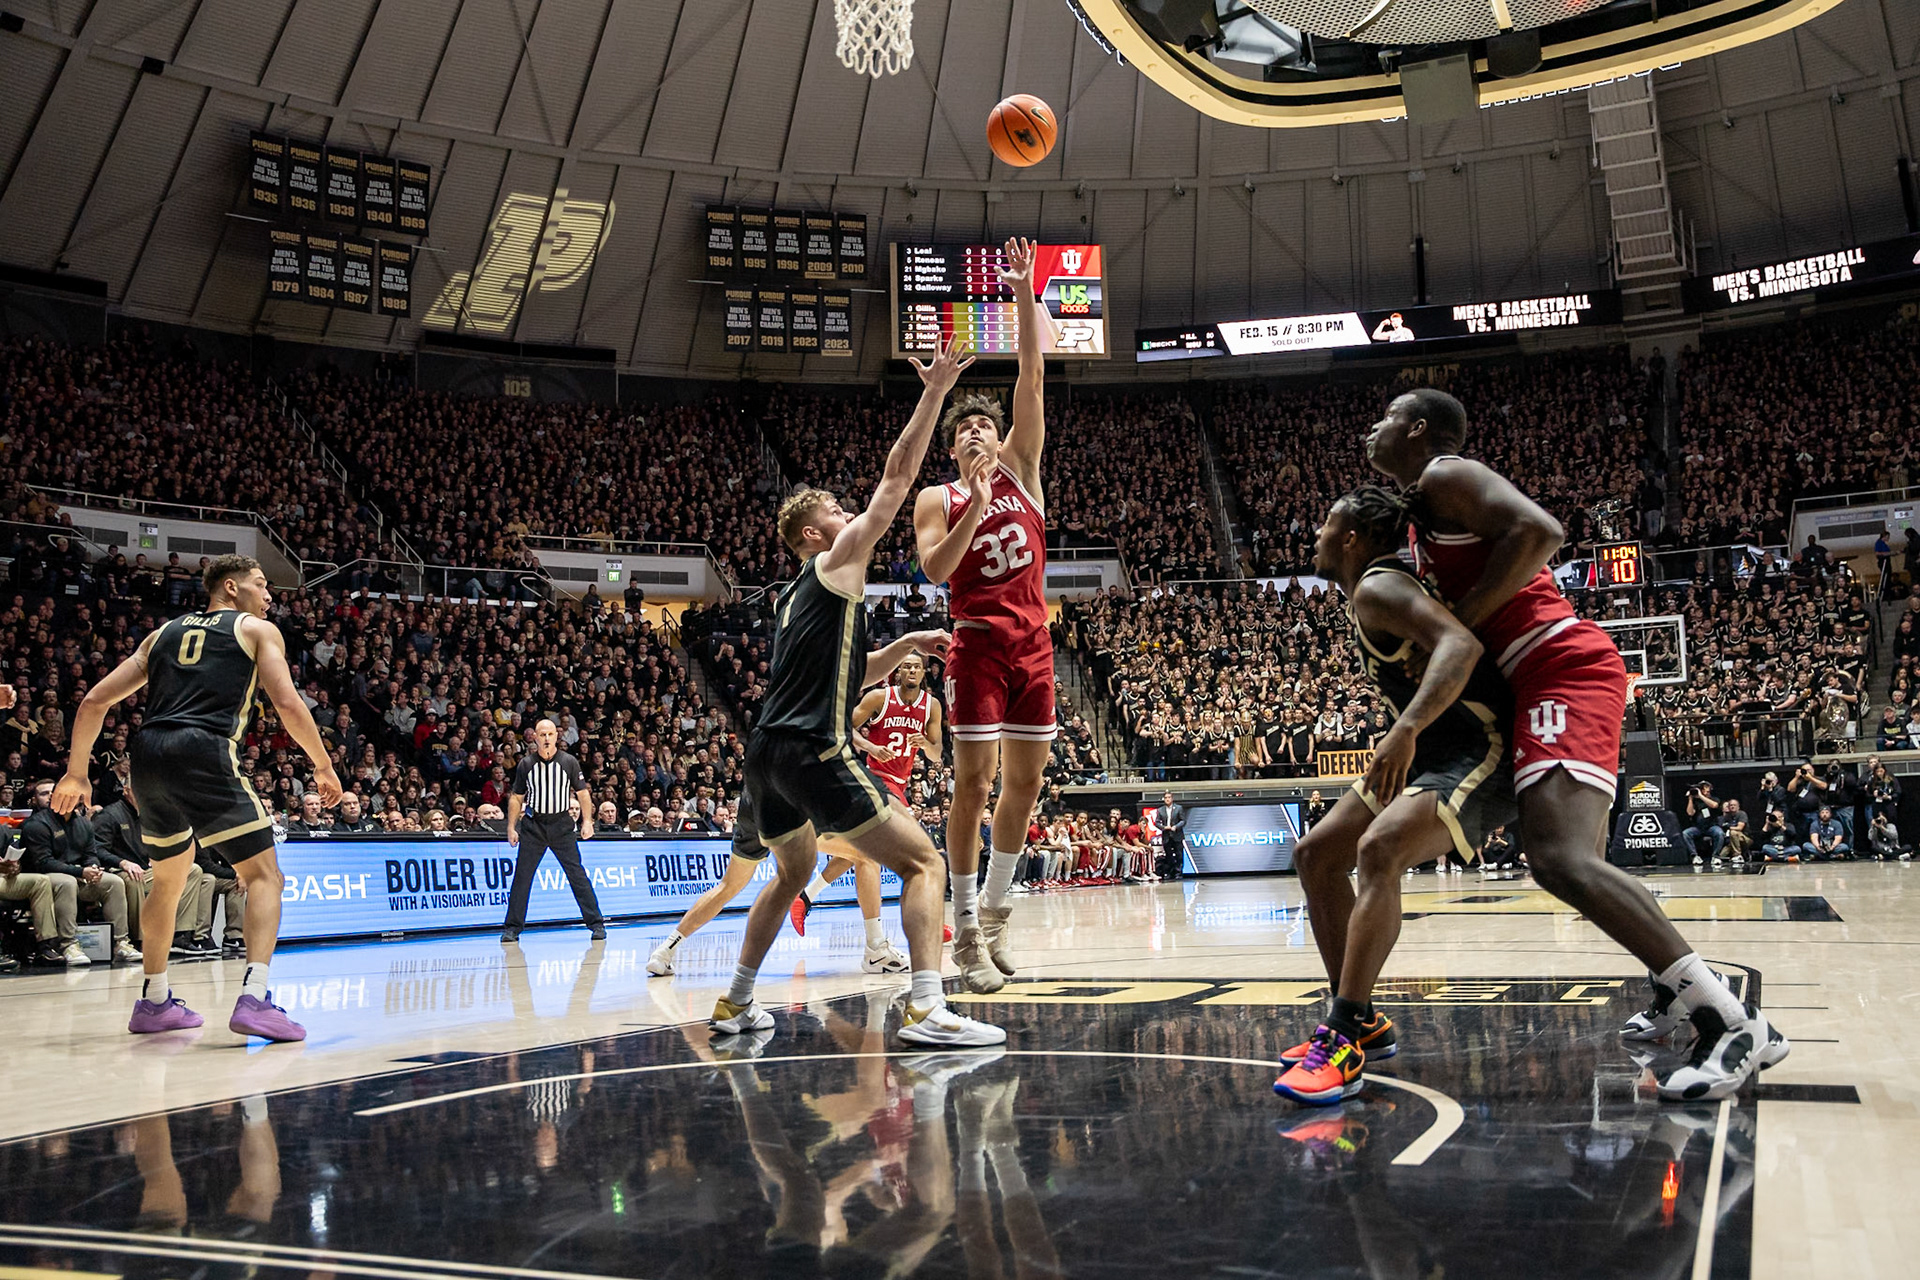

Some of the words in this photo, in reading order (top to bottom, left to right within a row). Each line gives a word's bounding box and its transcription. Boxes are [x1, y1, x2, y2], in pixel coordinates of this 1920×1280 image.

[253, 139, 282, 153] PURDUE
[291, 147, 320, 161] PURDUE
[257, 158, 277, 169] MEN'S
[328, 154, 357, 168] PURDUE
[254, 165, 265, 174] BIG
[267, 168, 279, 177] TEN
[294, 166, 315, 176] MEN'S
[365, 162, 393, 174] PURDUE
[253, 173, 280, 186] CHAMPS
[291, 173, 303, 182] BIG
[304, 175, 317, 185] TEN
[332, 173, 353, 183] MEN'S
[400, 168, 428, 181] PURDUE
[290, 180, 318, 192] CHAMPS
[330, 181, 341, 189] BIG
[343, 183, 355, 191] TEN
[254, 189, 278, 203] 1935
[328, 187, 356, 198] CHAMPS
[291, 195, 316, 211] 1936
[330, 203, 354, 216] 1938
[367, 210, 392, 223] 1940
[400, 216, 425, 229] 1969
[708, 212, 734, 221] PURDUE
[741, 214, 767, 223] PURDUE
[774, 217, 800, 225] PURDUE
[807, 218, 832, 227] PURDUE
[839, 220, 865, 229] PURDUE
[271, 231, 301, 242] PURDUE
[308, 237, 337, 248] PURDUE
[343, 243, 372, 255] PURDUE
[708, 242, 733, 250] CHAMPS
[742, 244, 767, 252] CHAMPS
[381, 249, 409, 261] PURDUE
[710, 256, 732, 266] 1994
[744, 258, 766, 268] 1995
[808, 262, 832, 272] 2009
[842, 263, 864, 273] 2010
[1713, 270, 1760, 291] MEN'S
[1764, 248, 1865, 280] BASKETBALL
[272, 280, 299, 293] 1979
[915, 284, 952, 292] Galloway
[1727, 288, 1754, 303] VS.
[1758, 266, 1852, 298] MINNESOTA
[309, 286, 334, 299] 1984
[344, 291, 368, 304] 1987
[726, 290, 752, 299] PURDUE
[759, 292, 785, 300] PURDUE
[792, 294, 817, 302] PURDUE
[382, 297, 407, 310] 1988
[824, 296, 849, 304] PURDUE
[1061, 304, 1089, 313] FOODS
[1453, 304, 1497, 320] MEN'S
[1501, 295, 1591, 316] BASKETBALL
[760, 321, 784, 329] CHAMPS
[1466, 319, 1492, 333] VS.
[1495, 310, 1579, 331] MINNESOTA
[1240, 327, 1262, 339] FEB.
[1268, 326, 1278, 336] 15
[1298, 323, 1322, 334] 8:30
[1326, 321, 1343, 332] PM
[728, 335, 750, 345] 2017
[761, 336, 783, 346] 2019
[793, 337, 817, 347] 2023
[825, 339, 849, 349] 2023
[504, 380, 531, 397] 103
[972, 523, 1032, 578] 32
[1603, 546, 1637, 560] 11:04
[1613, 559, 1635, 582] 10
[182, 614, 222, 626] GILLIS
[178, 629, 206, 665] 0
[1190, 831, 1285, 847] WABASH
[646, 854, 708, 882] BOILER
[386, 858, 477, 893] BOILER
[537, 867, 636, 890] WAASH
[845, 877, 849, 886] A
[649, 885, 669, 896] WITH
[671, 884, 676, 895] A
[389, 896, 417, 910] WITH
[421, 895, 429, 909] A
[431, 893, 485, 908] VISIONARY
[489, 892, 510, 905] LEA
